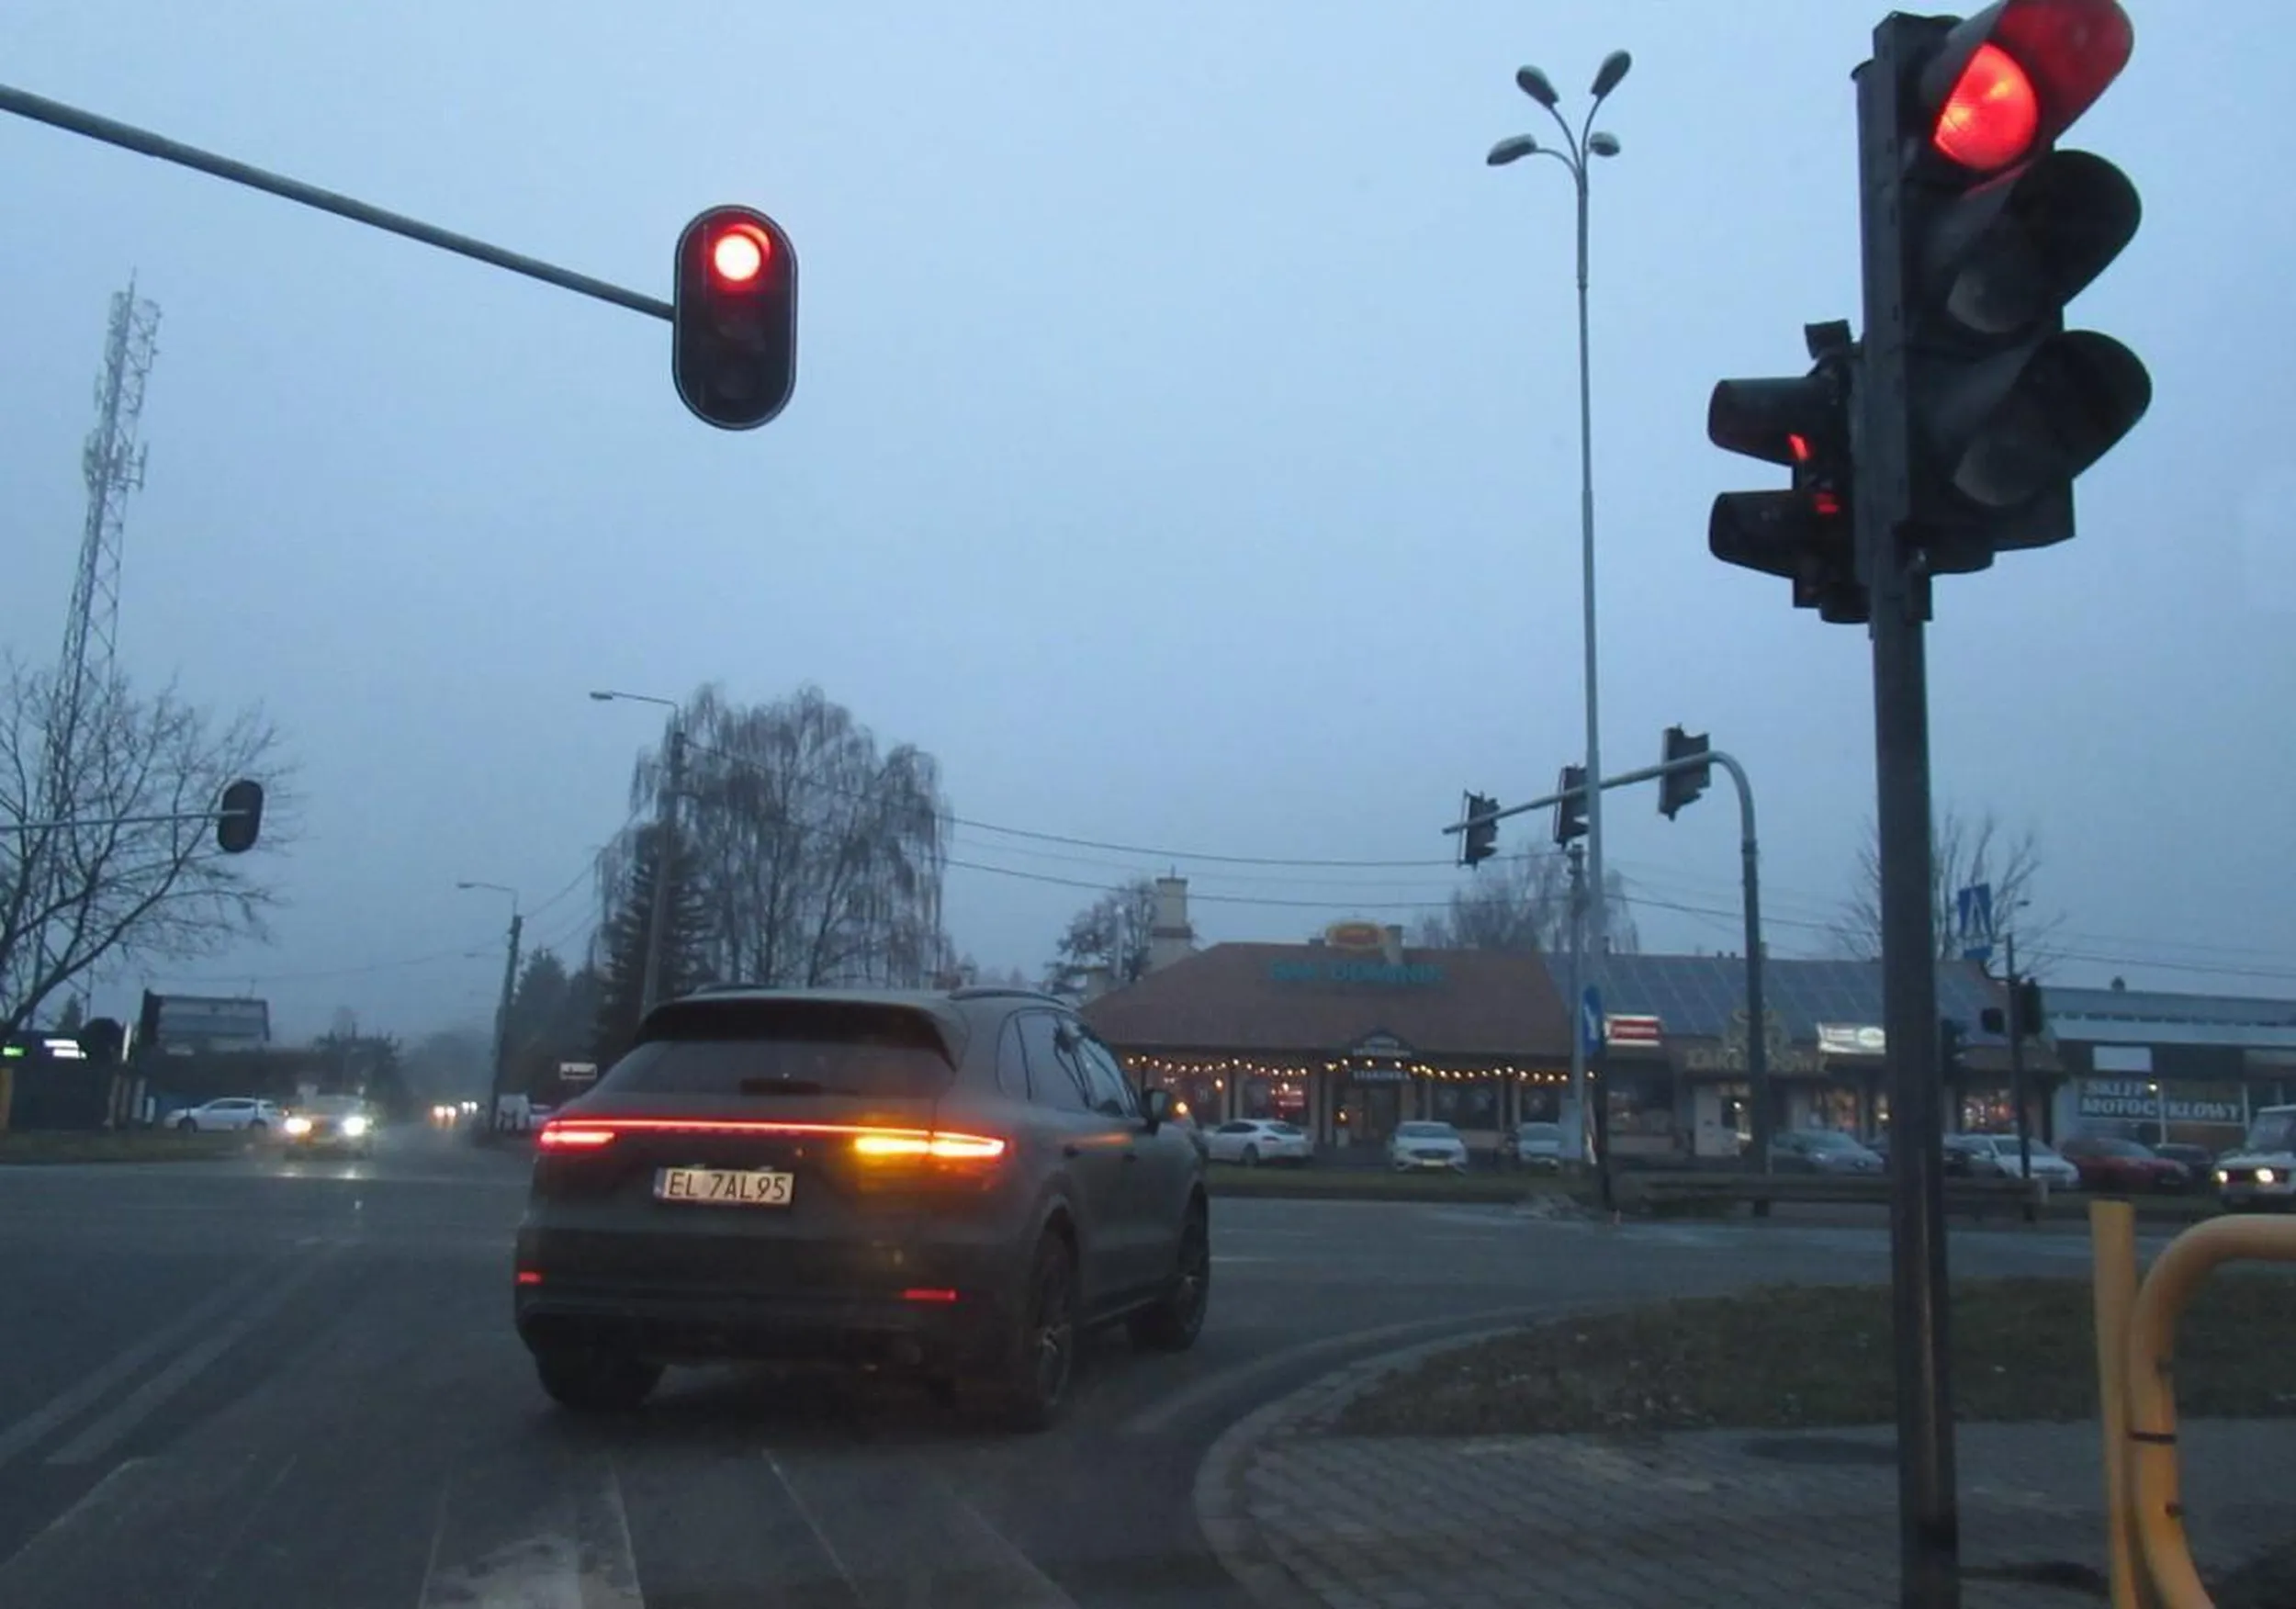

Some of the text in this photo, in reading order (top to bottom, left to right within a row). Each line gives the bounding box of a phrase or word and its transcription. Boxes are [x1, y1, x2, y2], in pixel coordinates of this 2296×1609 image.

[2082, 1097, 2241, 1120] MOTOCKLOWY
[669, 1171, 787, 1200] EL 7AL95
